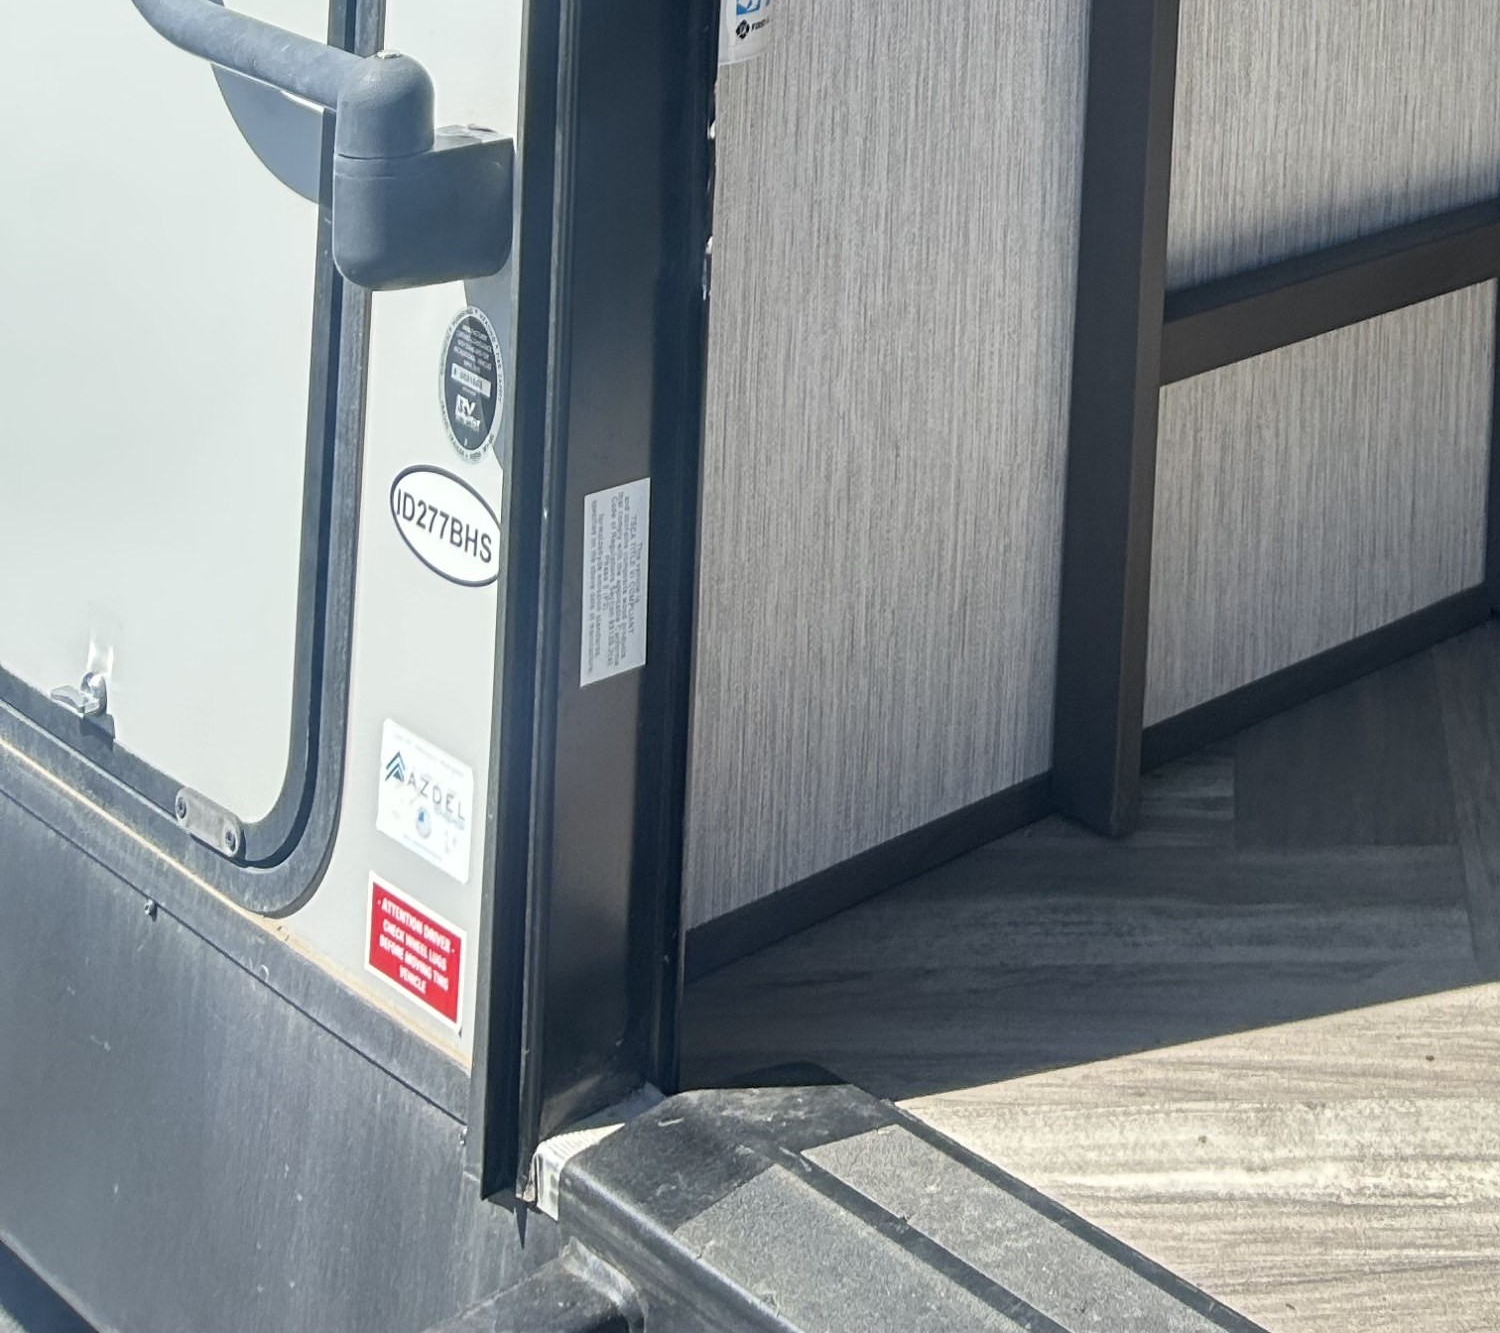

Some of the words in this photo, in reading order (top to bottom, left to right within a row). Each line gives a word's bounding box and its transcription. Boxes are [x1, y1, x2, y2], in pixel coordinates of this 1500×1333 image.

[396, 488, 493, 564] ID277BHS
[407, 772, 465, 821] AZDEL
[381, 897, 423, 936] ATTENTION
[423, 924, 451, 954] DRIVER
[379, 933, 404, 961] BEFORE
[404, 950, 432, 980] MOVING
[432, 969, 449, 992] THIS
[405, 933, 428, 959] WHEEL
[428, 949, 447, 972] LUGS
[399, 964, 426, 995] VEHICLE
